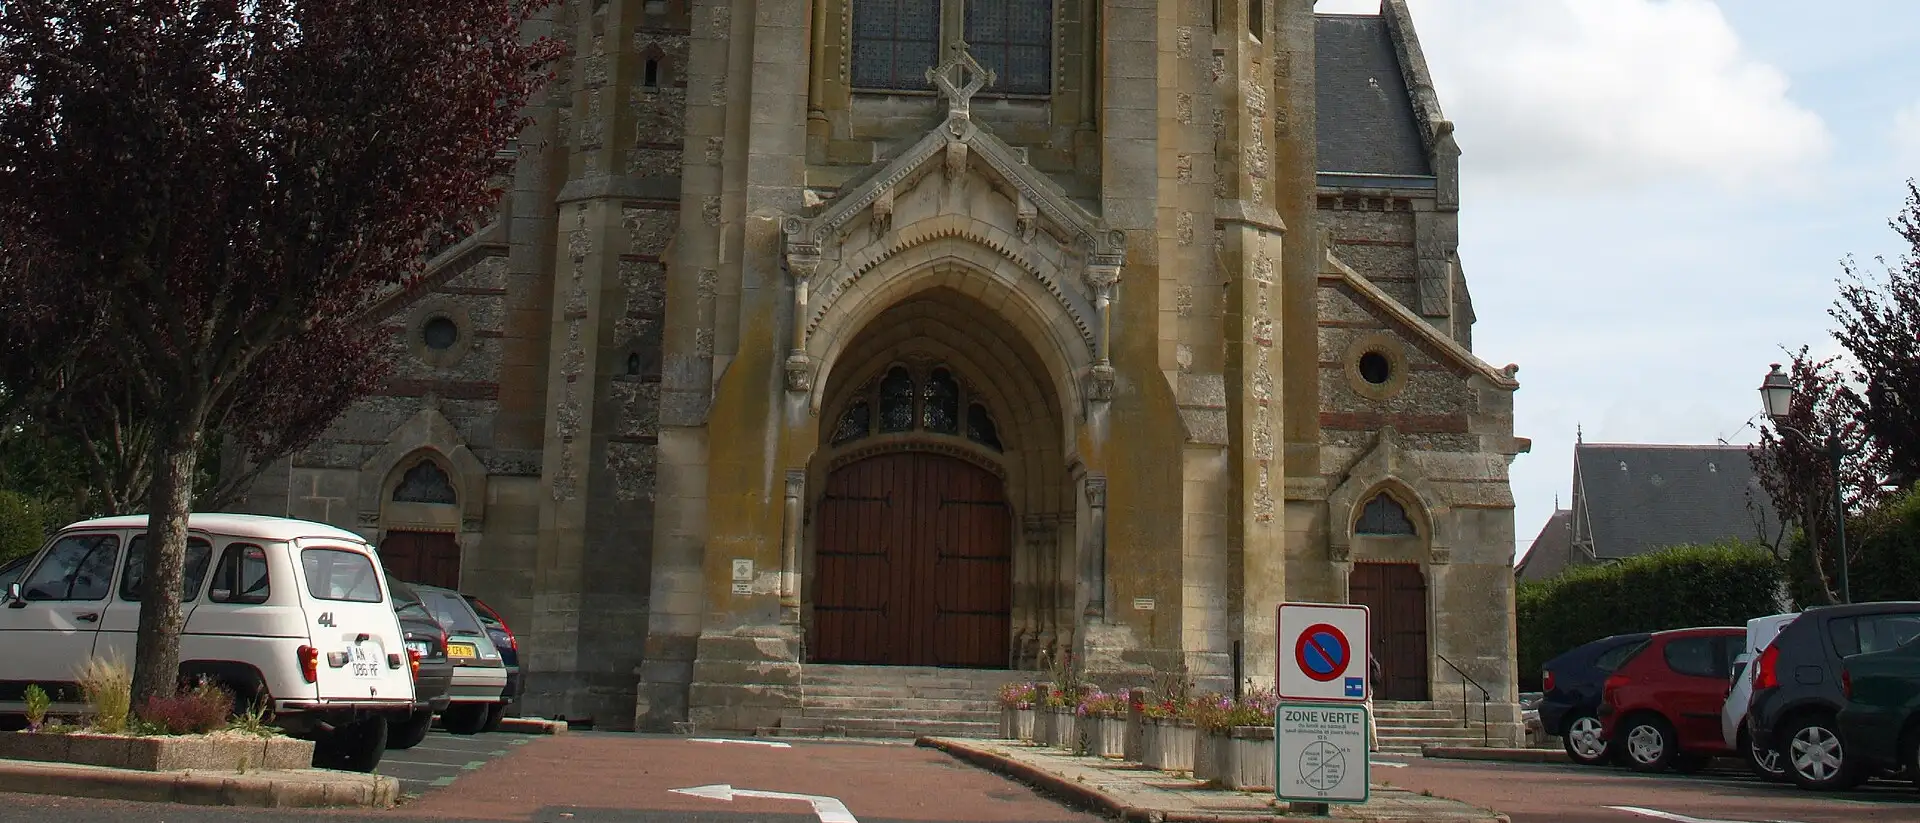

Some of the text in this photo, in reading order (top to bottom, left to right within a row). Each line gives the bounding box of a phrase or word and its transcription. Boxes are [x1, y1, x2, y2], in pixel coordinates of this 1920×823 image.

[318, 612, 337, 627] 4L
[1285, 710, 1360, 724] ZONE VERTE
